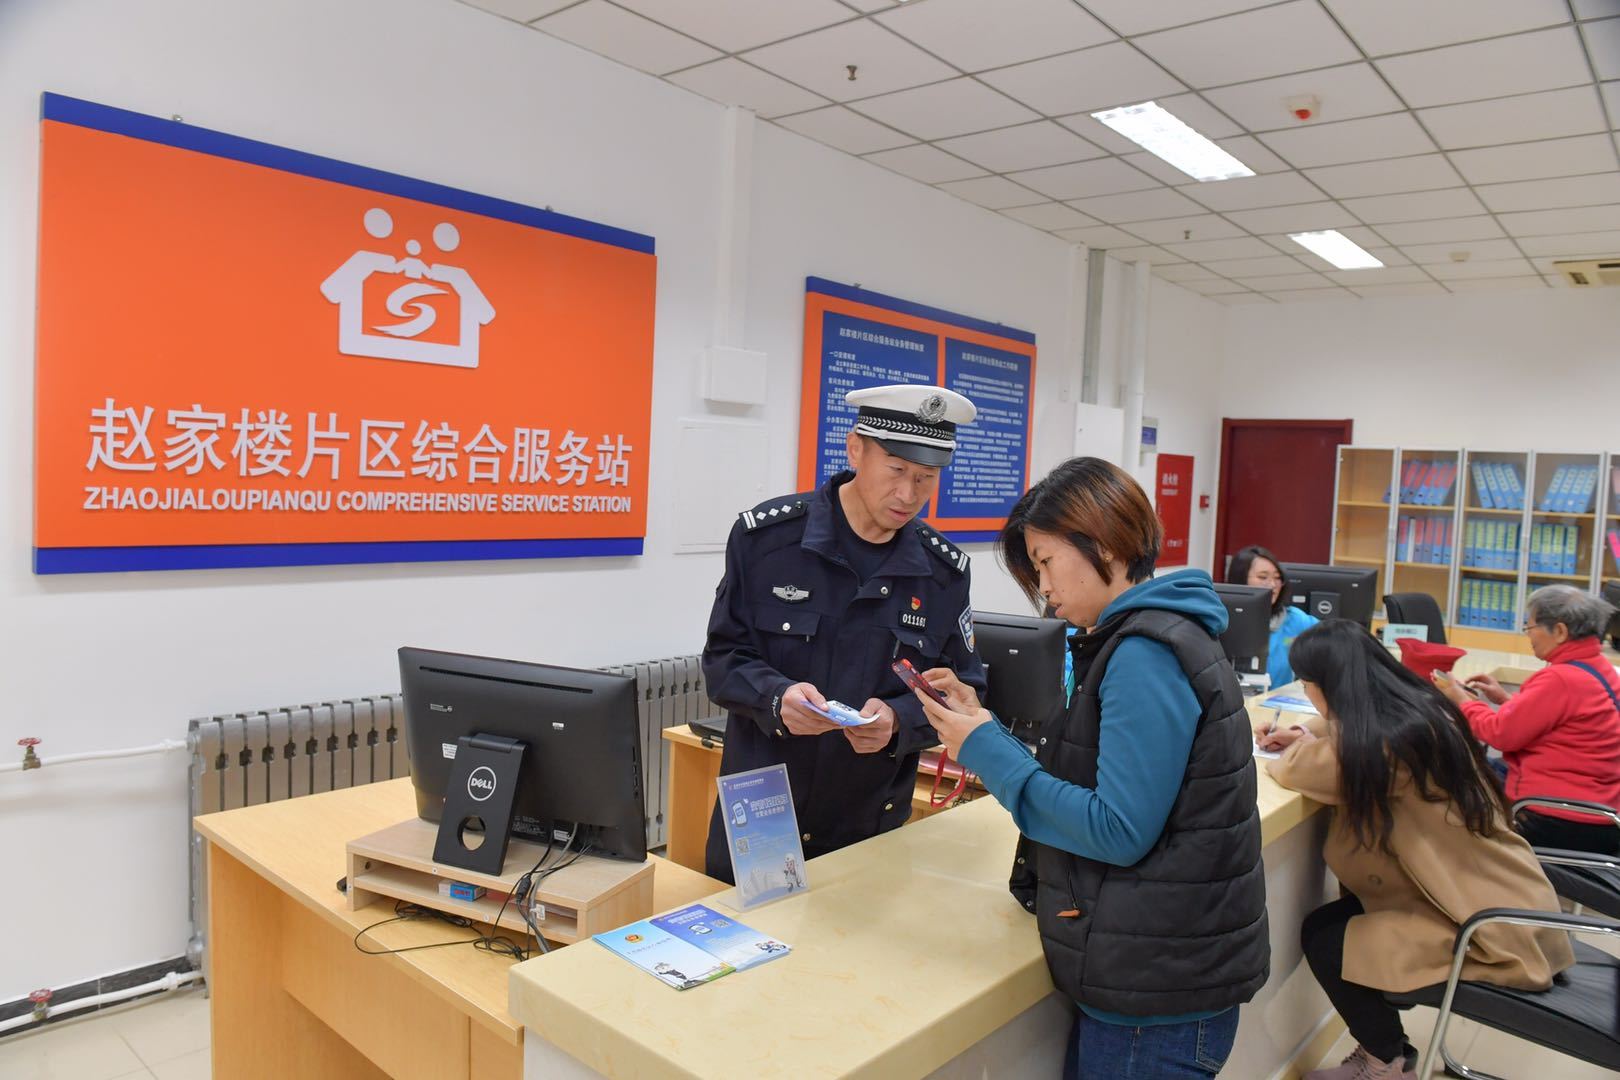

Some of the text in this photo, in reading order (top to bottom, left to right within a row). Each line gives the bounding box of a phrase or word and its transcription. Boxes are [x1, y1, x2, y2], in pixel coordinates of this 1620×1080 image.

[86, 397, 633, 486] 赵家楼片区综合服务站
[83, 486, 631, 513] ZHAOJIALOUPIANQU COMPREHENSIVE SERVICE STATION
[470, 777, 493, 790] DELL
